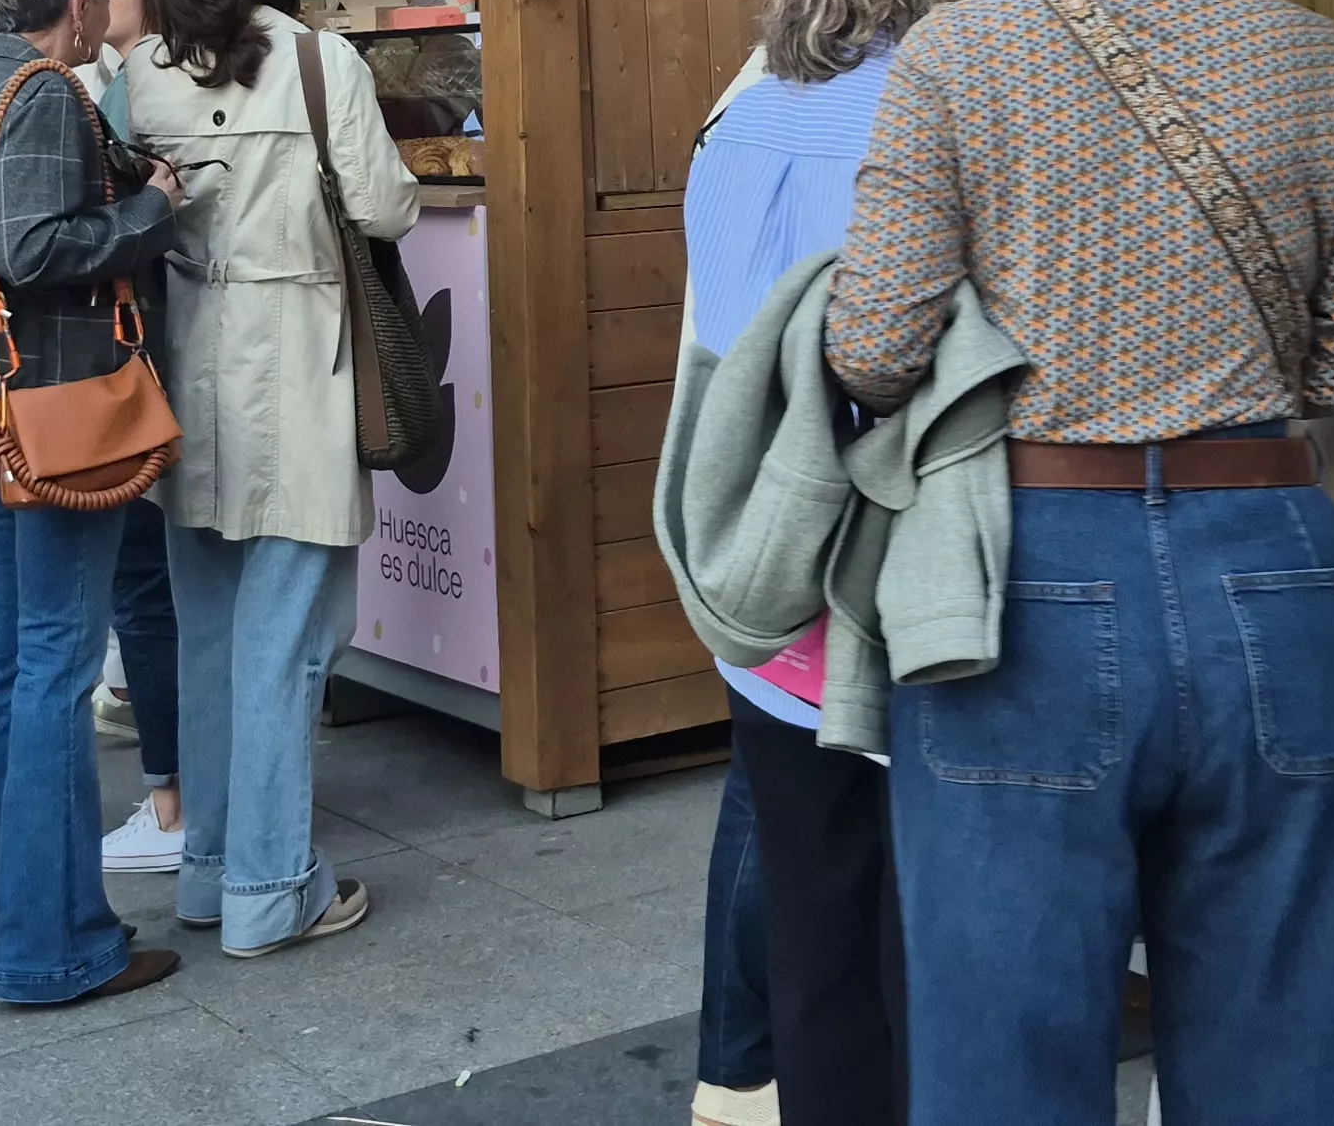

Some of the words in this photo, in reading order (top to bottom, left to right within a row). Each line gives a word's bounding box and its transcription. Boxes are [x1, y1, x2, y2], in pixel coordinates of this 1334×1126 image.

[380, 507, 452, 556] Huesca
[381, 553, 403, 582] es
[408, 551, 463, 599] dulce
